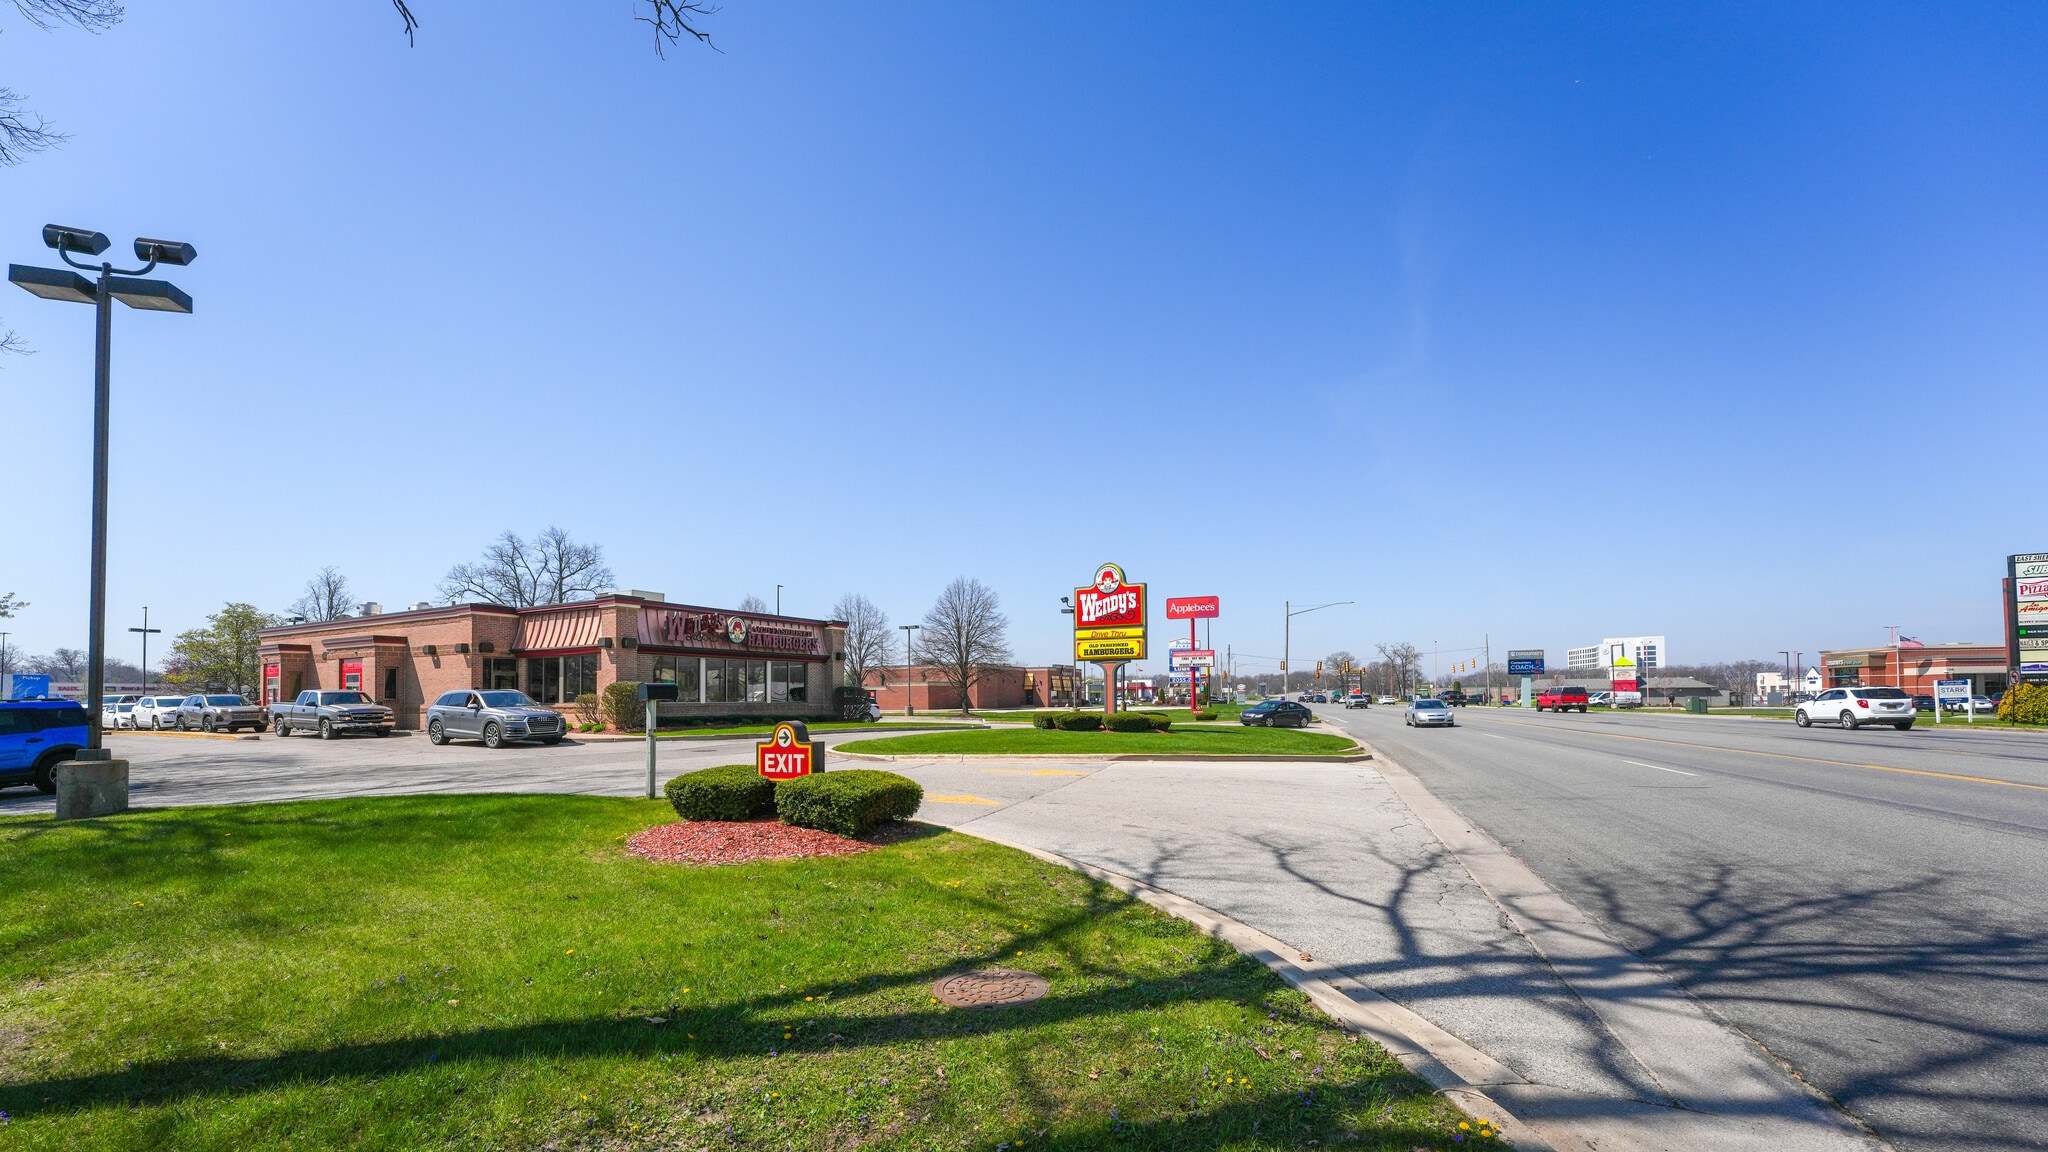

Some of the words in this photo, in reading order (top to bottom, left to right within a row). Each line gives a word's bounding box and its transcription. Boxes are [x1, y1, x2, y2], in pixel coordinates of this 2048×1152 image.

[1079, 591, 1137, 622] Wendy's
[1169, 602, 1216, 615] Applebee's
[1083, 647, 1135, 656] HAMBURGERS
[764, 753, 805, 773] EXIT
